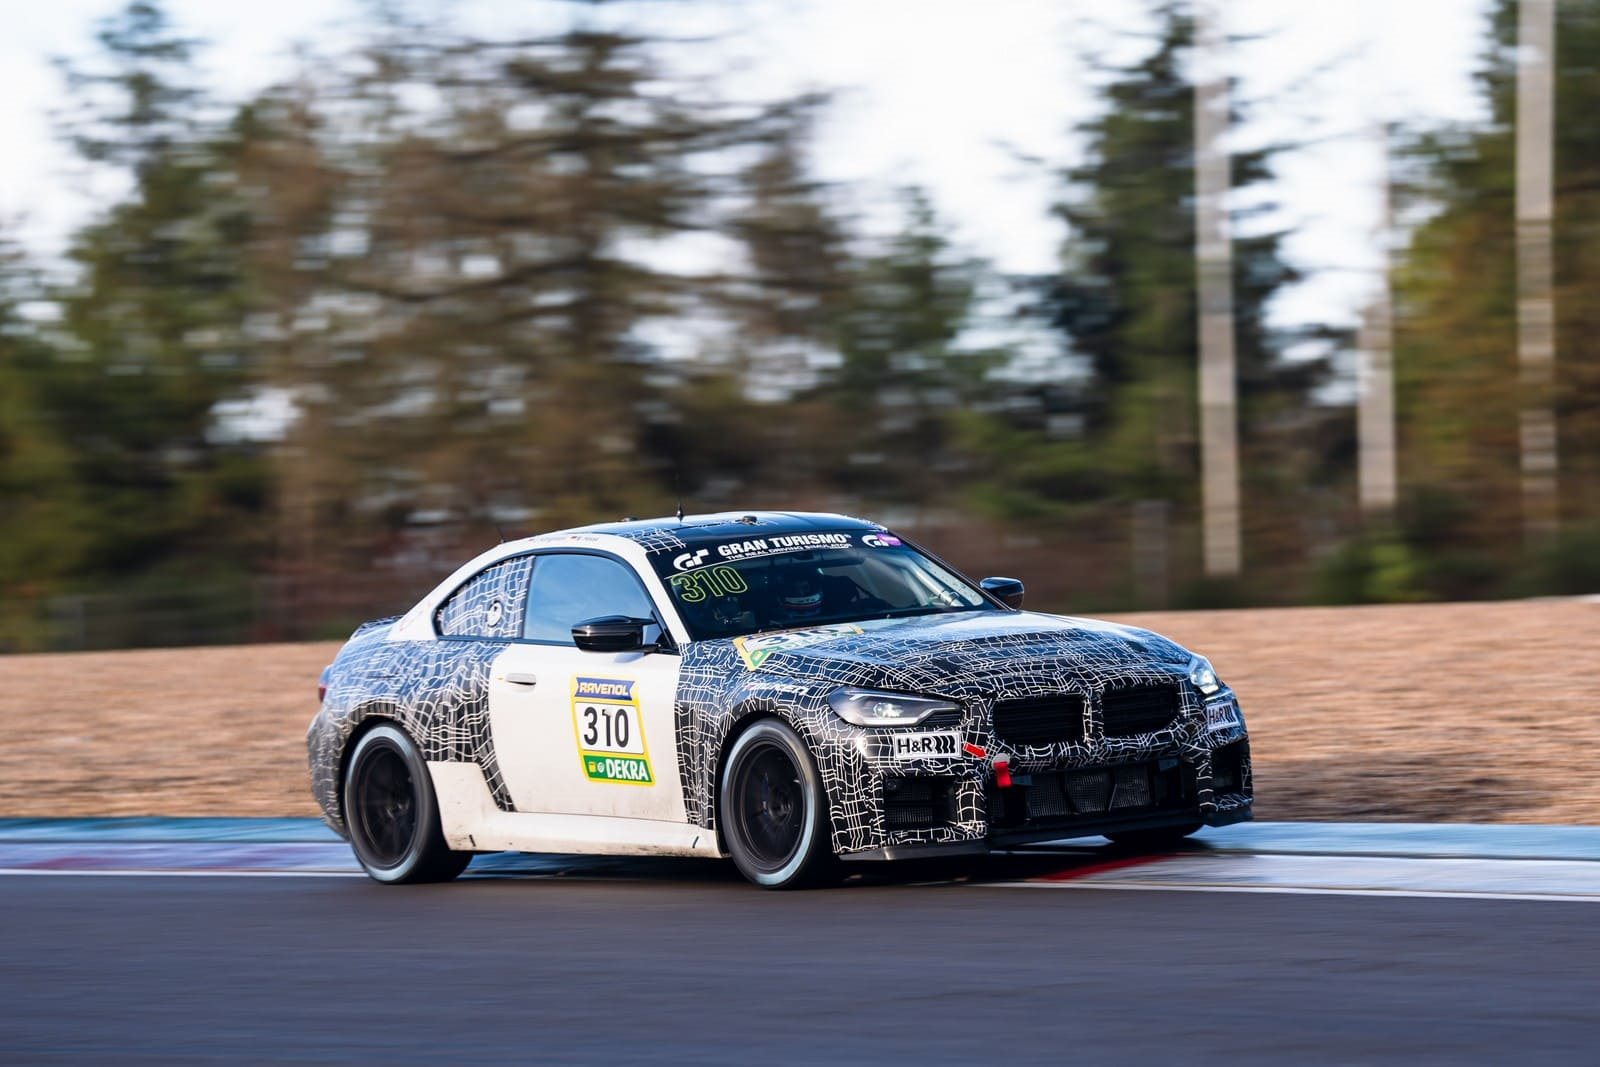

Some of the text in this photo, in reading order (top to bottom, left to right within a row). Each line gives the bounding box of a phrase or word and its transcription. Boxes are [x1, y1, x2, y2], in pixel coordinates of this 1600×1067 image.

[717, 533, 848, 557] GRAN TURISMO
[671, 566, 748, 602] 310
[579, 682, 629, 696] RAVENOL
[583, 706, 629, 748] 310
[897, 737, 932, 753] H&R
[605, 758, 649, 781] DEKRA
